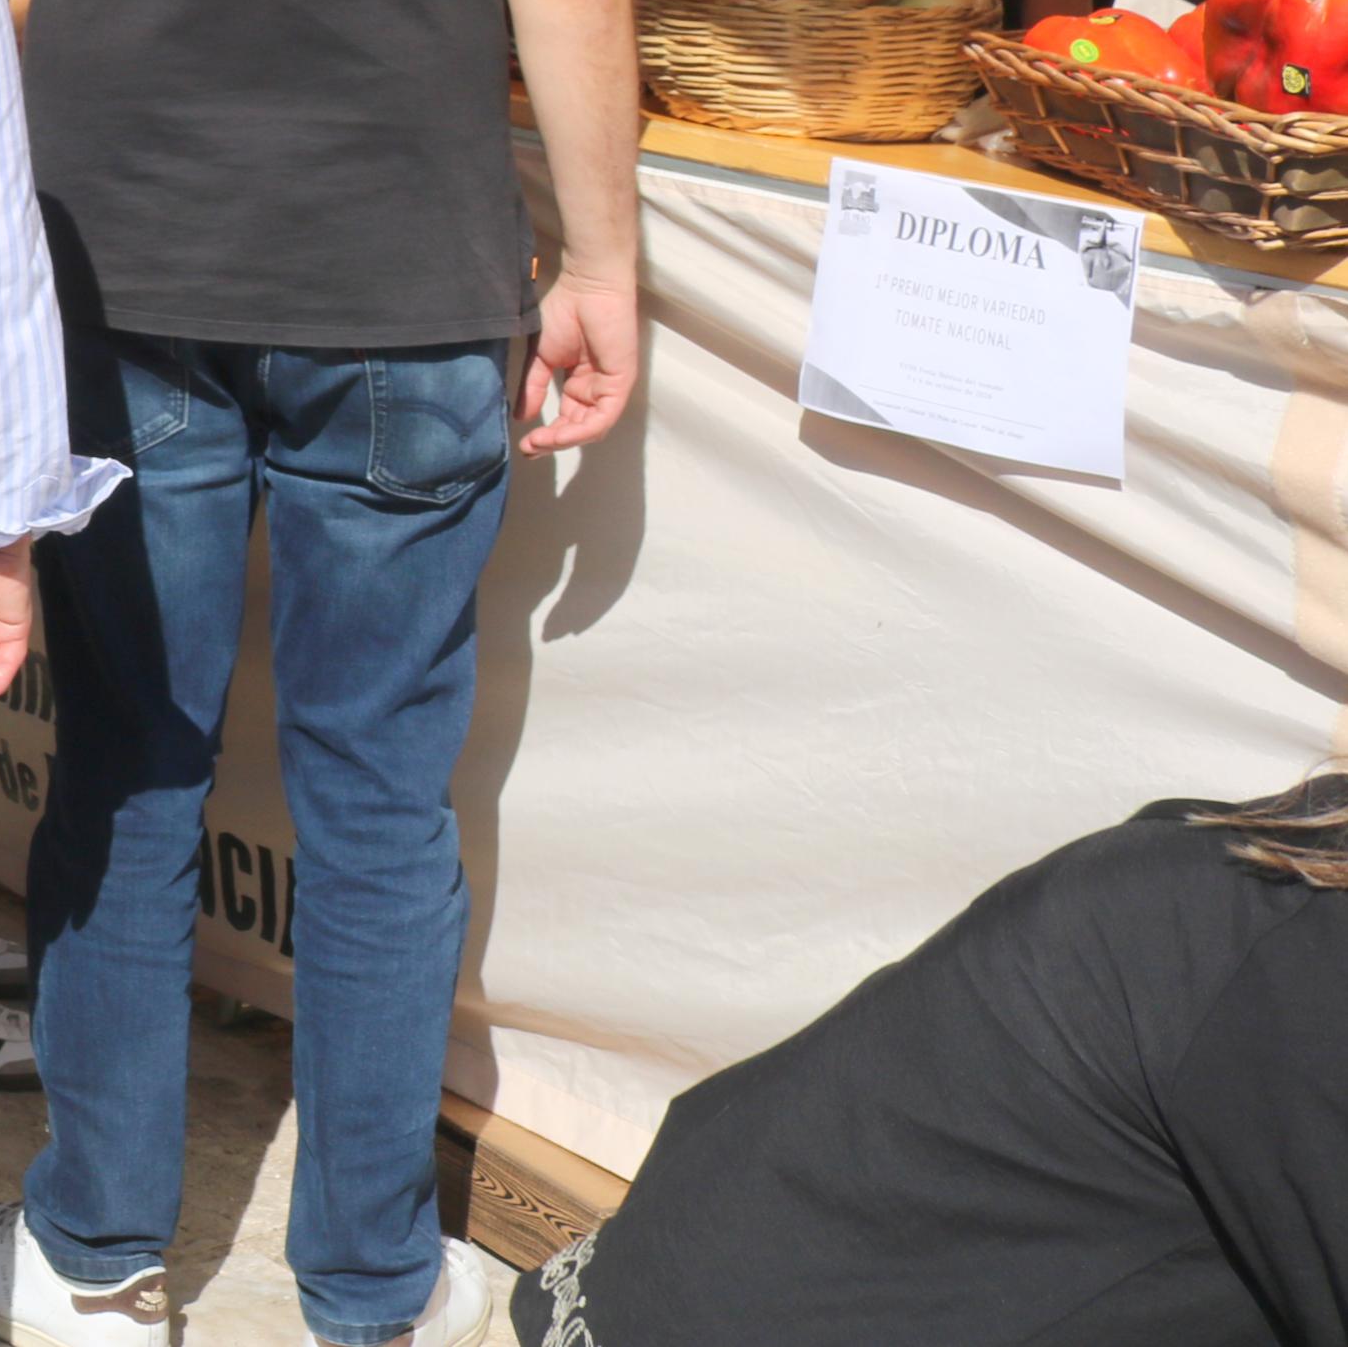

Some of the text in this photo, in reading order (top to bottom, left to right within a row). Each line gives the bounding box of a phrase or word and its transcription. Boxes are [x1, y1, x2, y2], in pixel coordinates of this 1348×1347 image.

[896, 211, 1046, 270] DIPLOMA
[890, 276, 933, 301] PREMIO
[937, 288, 979, 310] MEJOR
[983, 297, 1047, 326] VARIEDAD
[895, 308, 1012, 351] TOMATE NACIONAL
